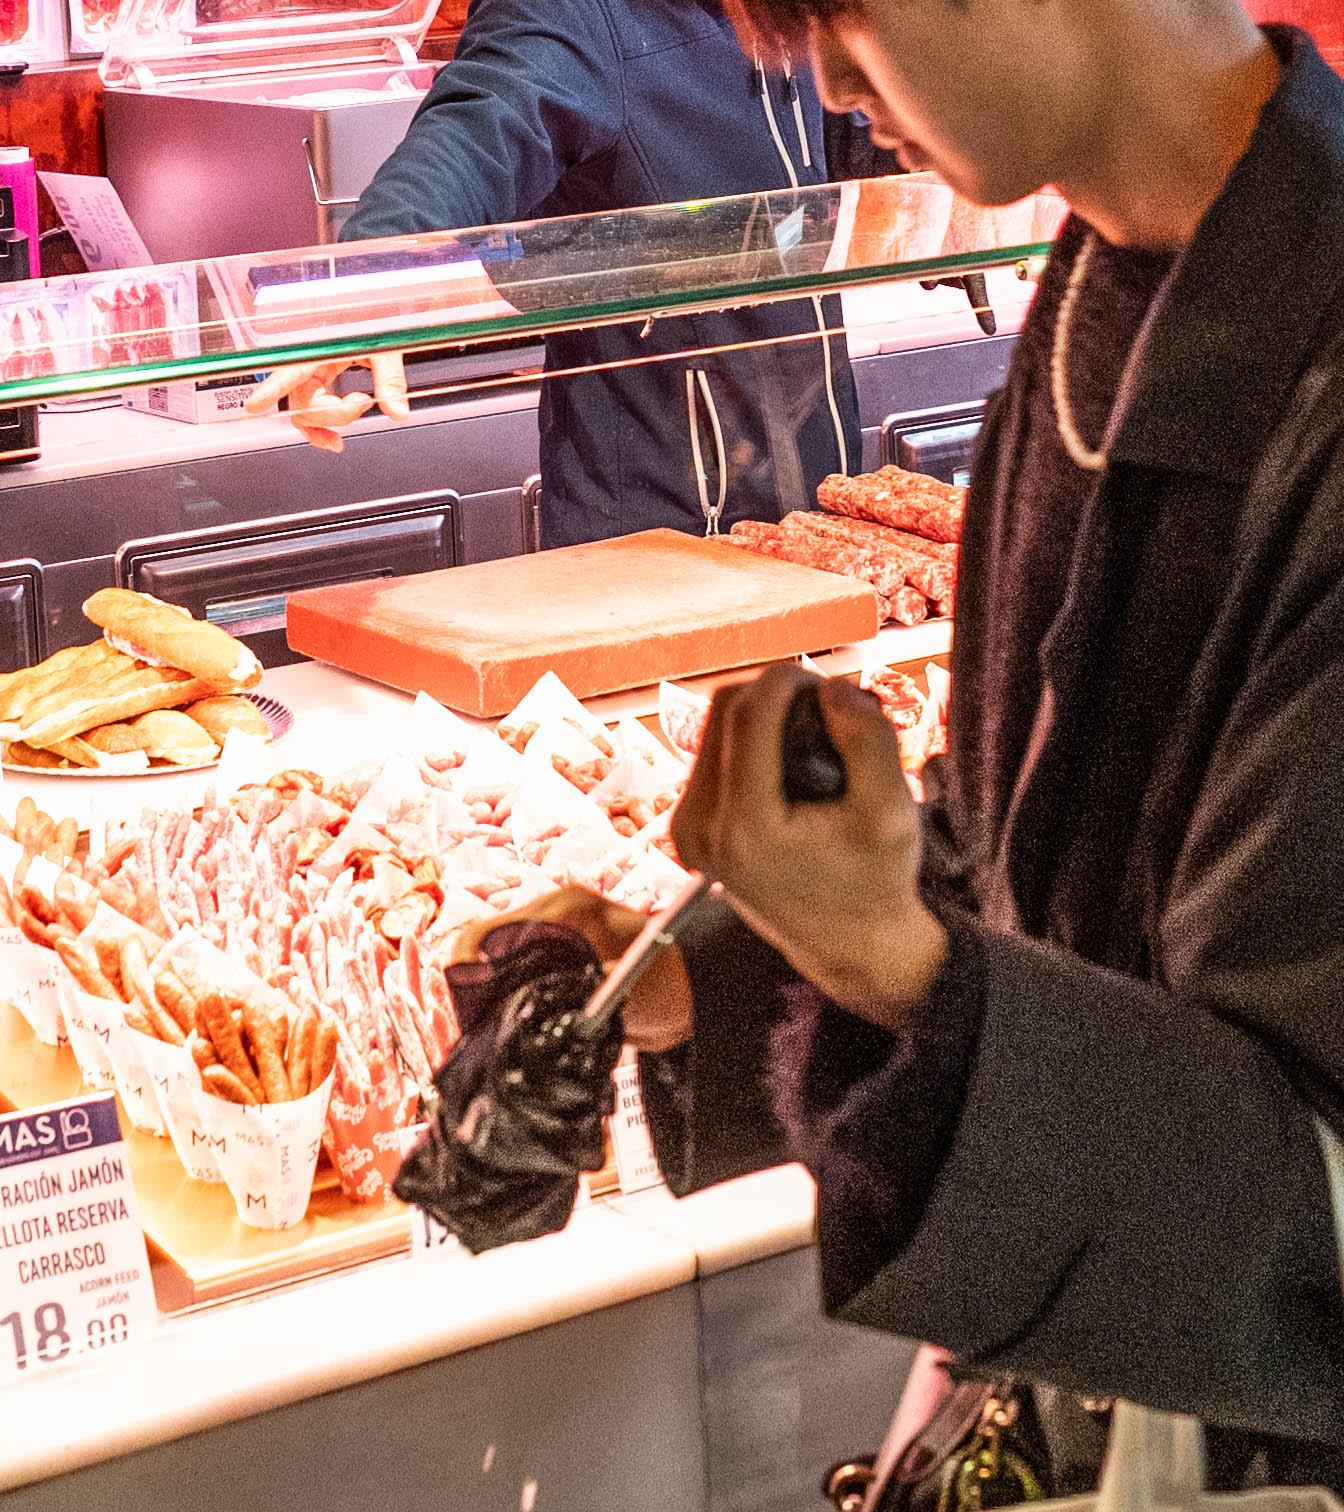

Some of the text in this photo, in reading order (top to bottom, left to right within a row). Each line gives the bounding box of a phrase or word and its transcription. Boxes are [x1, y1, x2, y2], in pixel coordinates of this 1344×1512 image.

[2, 1170, 63, 1210] RACIÓN
[67, 1156, 125, 1194] JAMÓN
[56, 1199, 130, 1236] RESERVA
[17, 1242, 107, 1285] CARRASCO
